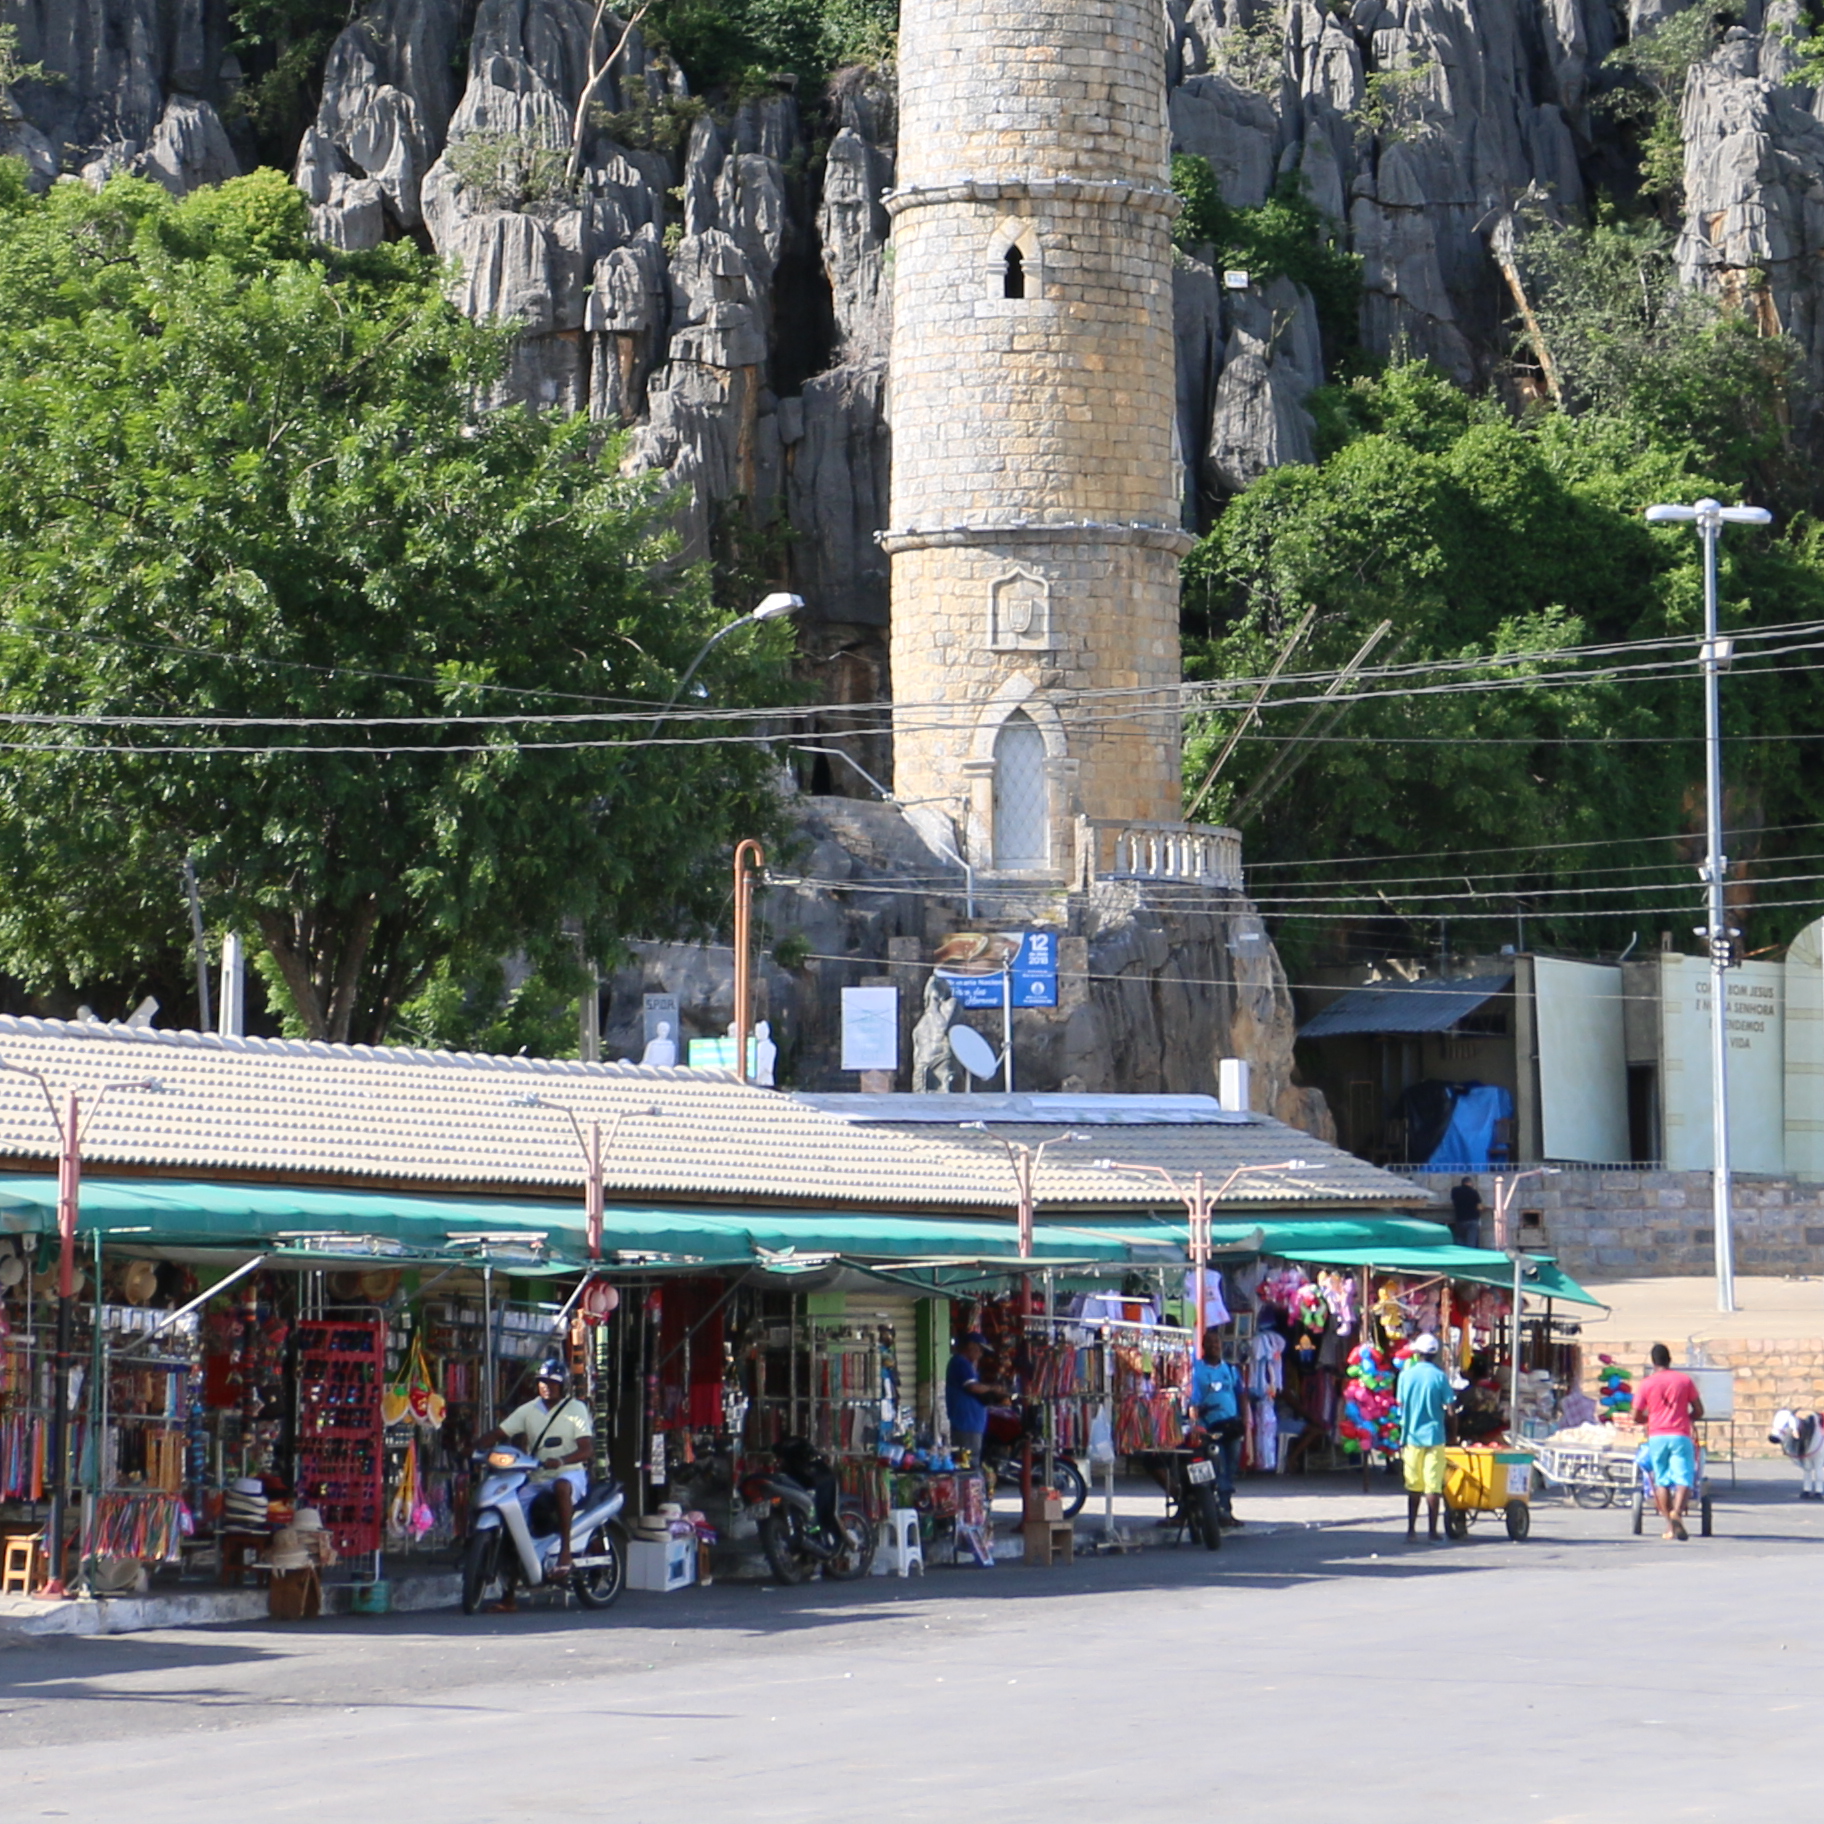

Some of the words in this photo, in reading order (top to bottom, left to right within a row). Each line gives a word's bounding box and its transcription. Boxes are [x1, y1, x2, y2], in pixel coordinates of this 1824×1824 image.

[1029, 933, 1049, 951] 12
[1728, 984, 1748, 996] BOM
[1749, 986, 1774, 998] JESUS
[1734, 1002, 1775, 1016] SENHORA
[1730, 1038, 1751, 1049] VIDA
